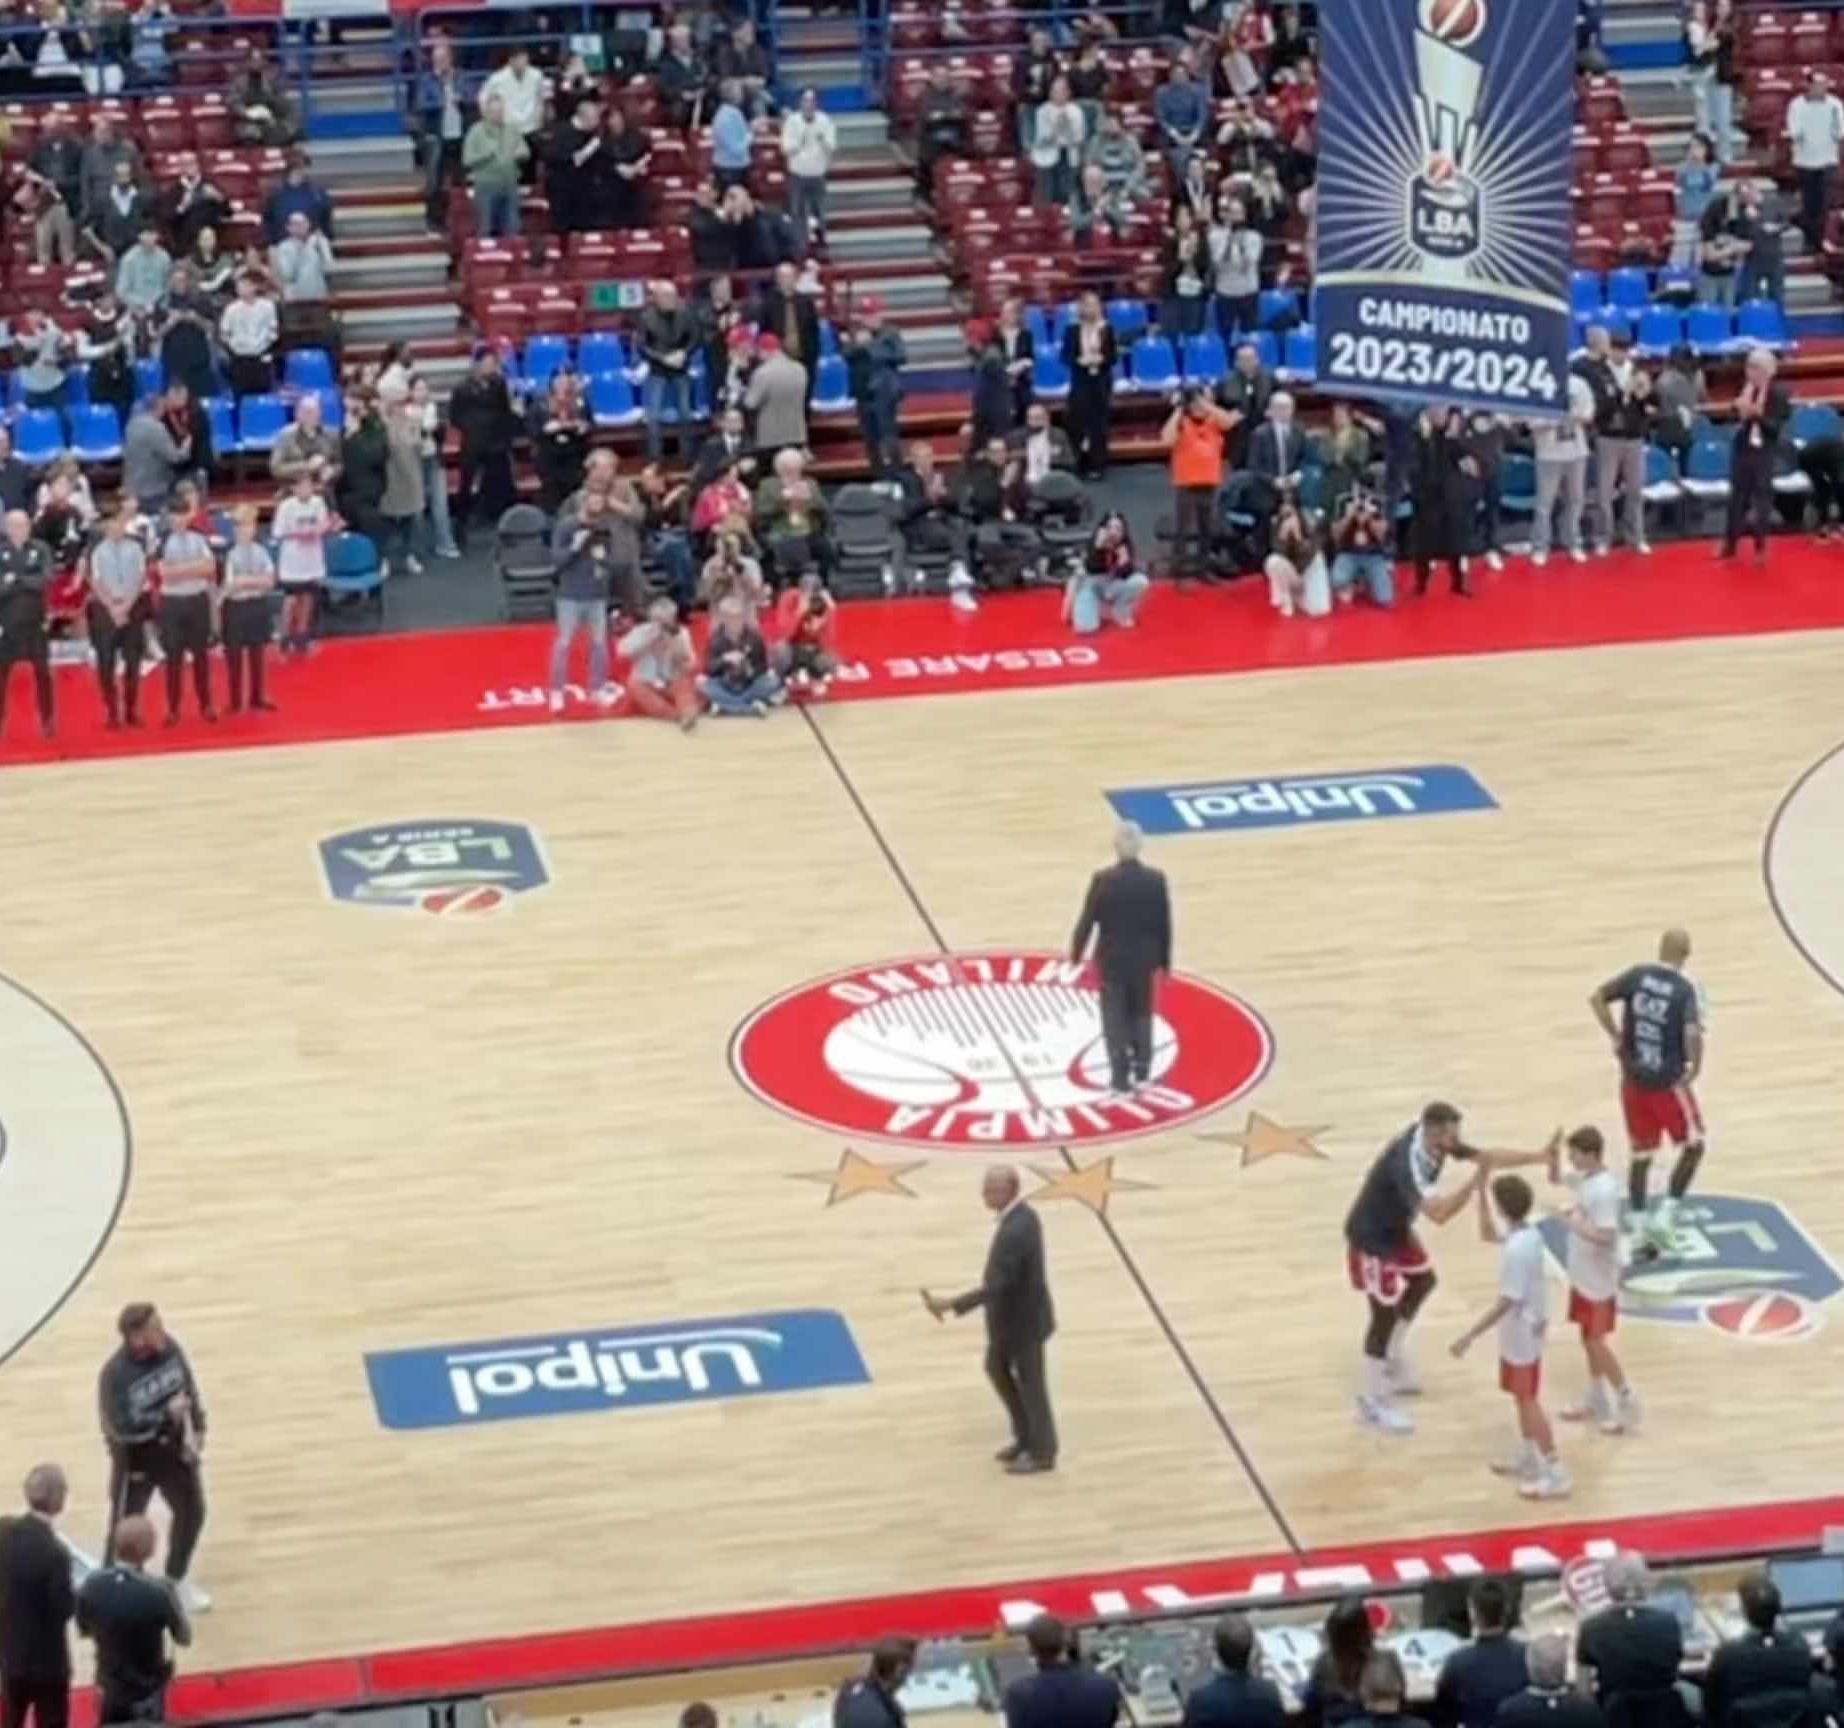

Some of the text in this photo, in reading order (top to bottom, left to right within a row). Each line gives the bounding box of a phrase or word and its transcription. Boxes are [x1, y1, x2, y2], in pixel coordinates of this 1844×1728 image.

[1418, 208, 1475, 238] LBA
[1359, 297, 1531, 345] CAMPIONATO
[1329, 333, 1558, 401] 2023/2024
[885, 645, 1100, 680] CESARE
[1168, 777, 1420, 828] Unipol
[340, 836, 513, 871] LBA
[829, 959, 1090, 1005] MILANO
[884, 1085, 1196, 1141] OLIMPIA
[448, 1333, 771, 1414] Unipol
